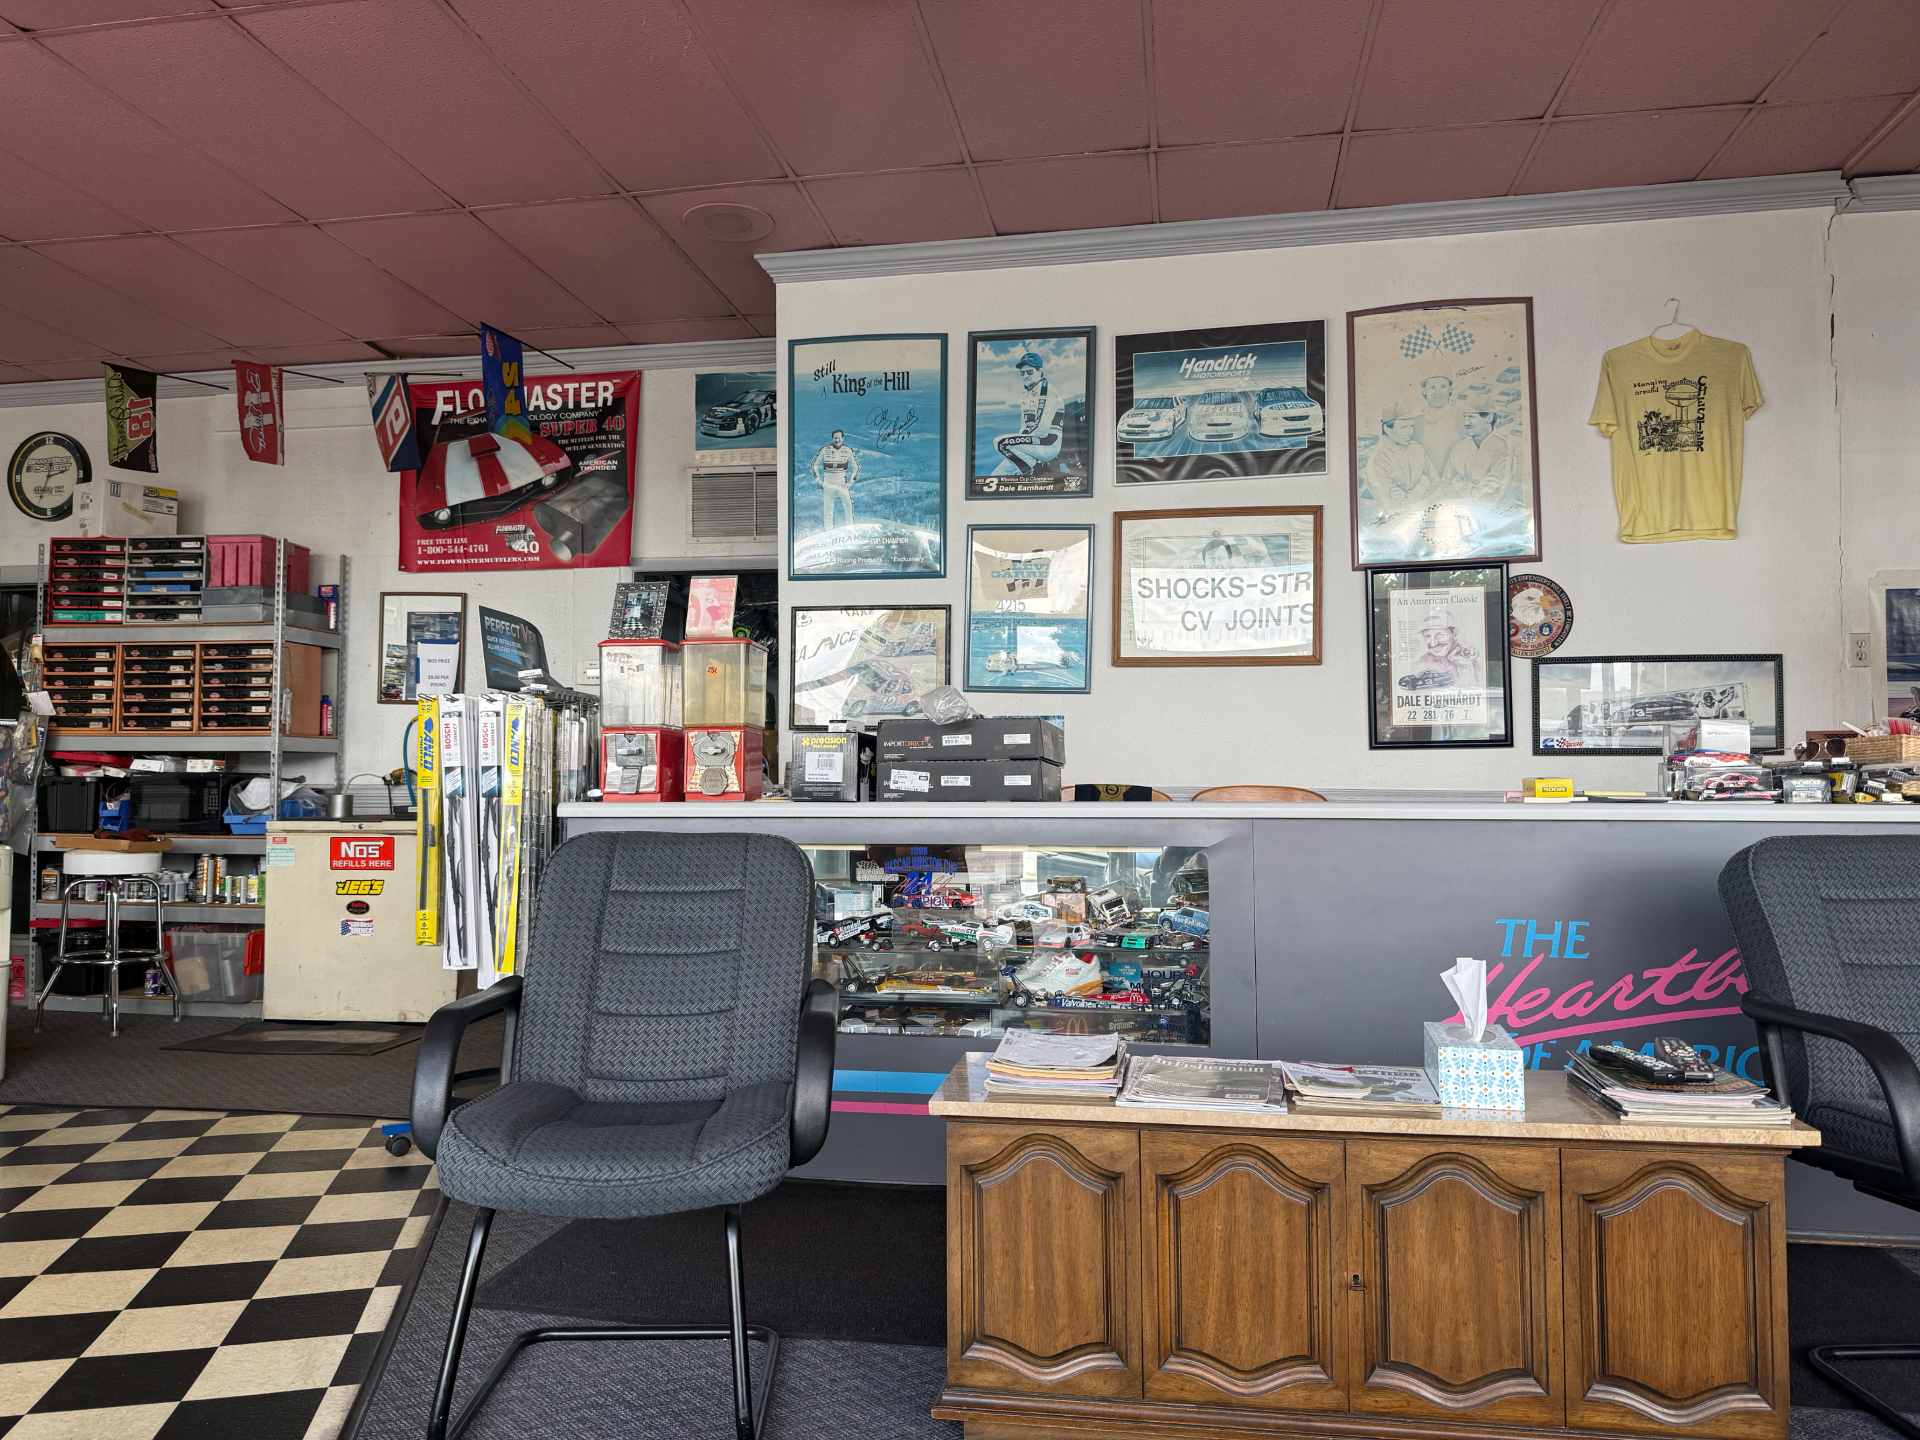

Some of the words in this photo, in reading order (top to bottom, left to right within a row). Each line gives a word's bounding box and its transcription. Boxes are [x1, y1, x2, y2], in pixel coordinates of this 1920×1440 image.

[813, 359, 837, 382] Still
[1179, 353, 1258, 379] Hendrick
[1192, 369, 1251, 379] MOTORSPORTS
[832, 373, 867, 396] King
[866, 379, 873, 388] of
[873, 377, 883, 387] the
[883, 371, 910, 391] Hill
[1634, 387, 1659, 396] around
[431, 381, 615, 425] FLOASTER
[450, 417, 466, 425] THE
[467, 416, 488, 425] EXHA
[560, 409, 600, 420] COMPANY
[540, 419, 598, 437] SUPER
[602, 415, 625, 431] 40
[45, 436, 54, 445] 12
[16, 474, 20, 483] 9
[78, 470, 83, 478] 3
[983, 477, 999, 492] 3
[1017, 484, 1054, 492] Earnhardt
[47, 508, 52, 516] 6
[495, 524, 526, 535] FLOWMASTER
[417, 544, 489, 555] 1-800-544-4761
[519, 541, 540, 554] 40
[1397, 598, 1409, 606] An
[1411, 596, 1449, 605] American
[1450, 595, 1479, 604] Classic
[1181, 611, 1214, 631] CV
[1225, 603, 1313, 632] JOINTS
[1397, 695, 1422, 708] DALE
[1424, 693, 1482, 708] EARNHARDT
[1407, 710, 1417, 720] 22
[1423, 710, 1438, 720] 281
[1444, 710, 1455, 720] 76
[1463, 709, 1469, 719] 7
[1635, 708, 1646, 717] 3
[443, 723, 452, 750] BOSCH
[810, 736, 847, 745] precision
[423, 731, 434, 772] ANCO
[510, 729, 521, 766] ANCO
[341, 841, 380, 858] NOS
[332, 860, 367, 868] REFILLS
[368, 860, 392, 868] HERE
[337, 879, 384, 895] JEG'S
[966, 927, 979, 935] GTX
[1496, 919, 1590, 959] THE
[920, 973, 935, 982] 25
[1140, 970, 1193, 979] HOURS
[1443, 948, 1748, 1028] Heartb
[1061, 999, 1097, 1009] Valvoline
[1108, 1022, 1134, 1031] System
[1142, 1022, 1193, 1031] SUNDAY
